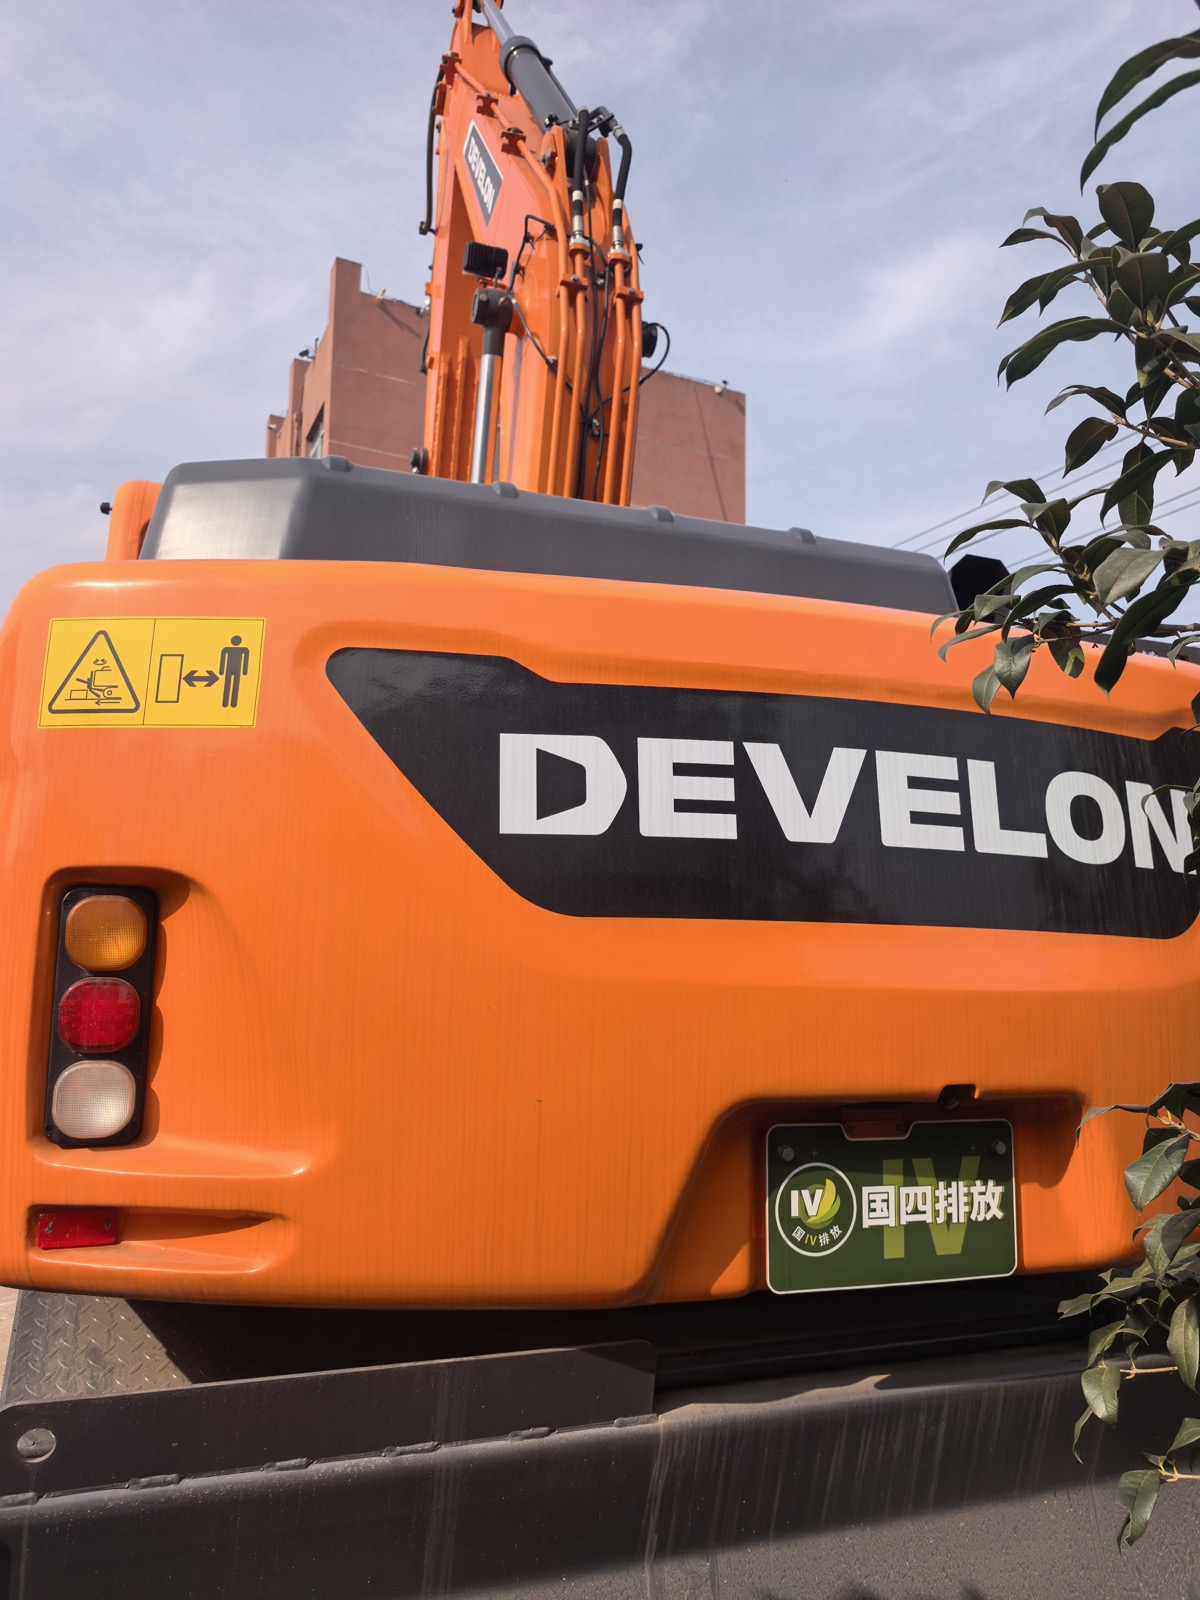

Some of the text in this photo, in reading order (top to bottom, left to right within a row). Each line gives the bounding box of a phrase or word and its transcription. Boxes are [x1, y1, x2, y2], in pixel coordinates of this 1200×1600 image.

[468, 136, 495, 214] DEVELON
[499, 733, 1197, 875] DEVELON
[791, 1189, 823, 1217] IV
[862, 1179, 1004, 1229] 国四排放
